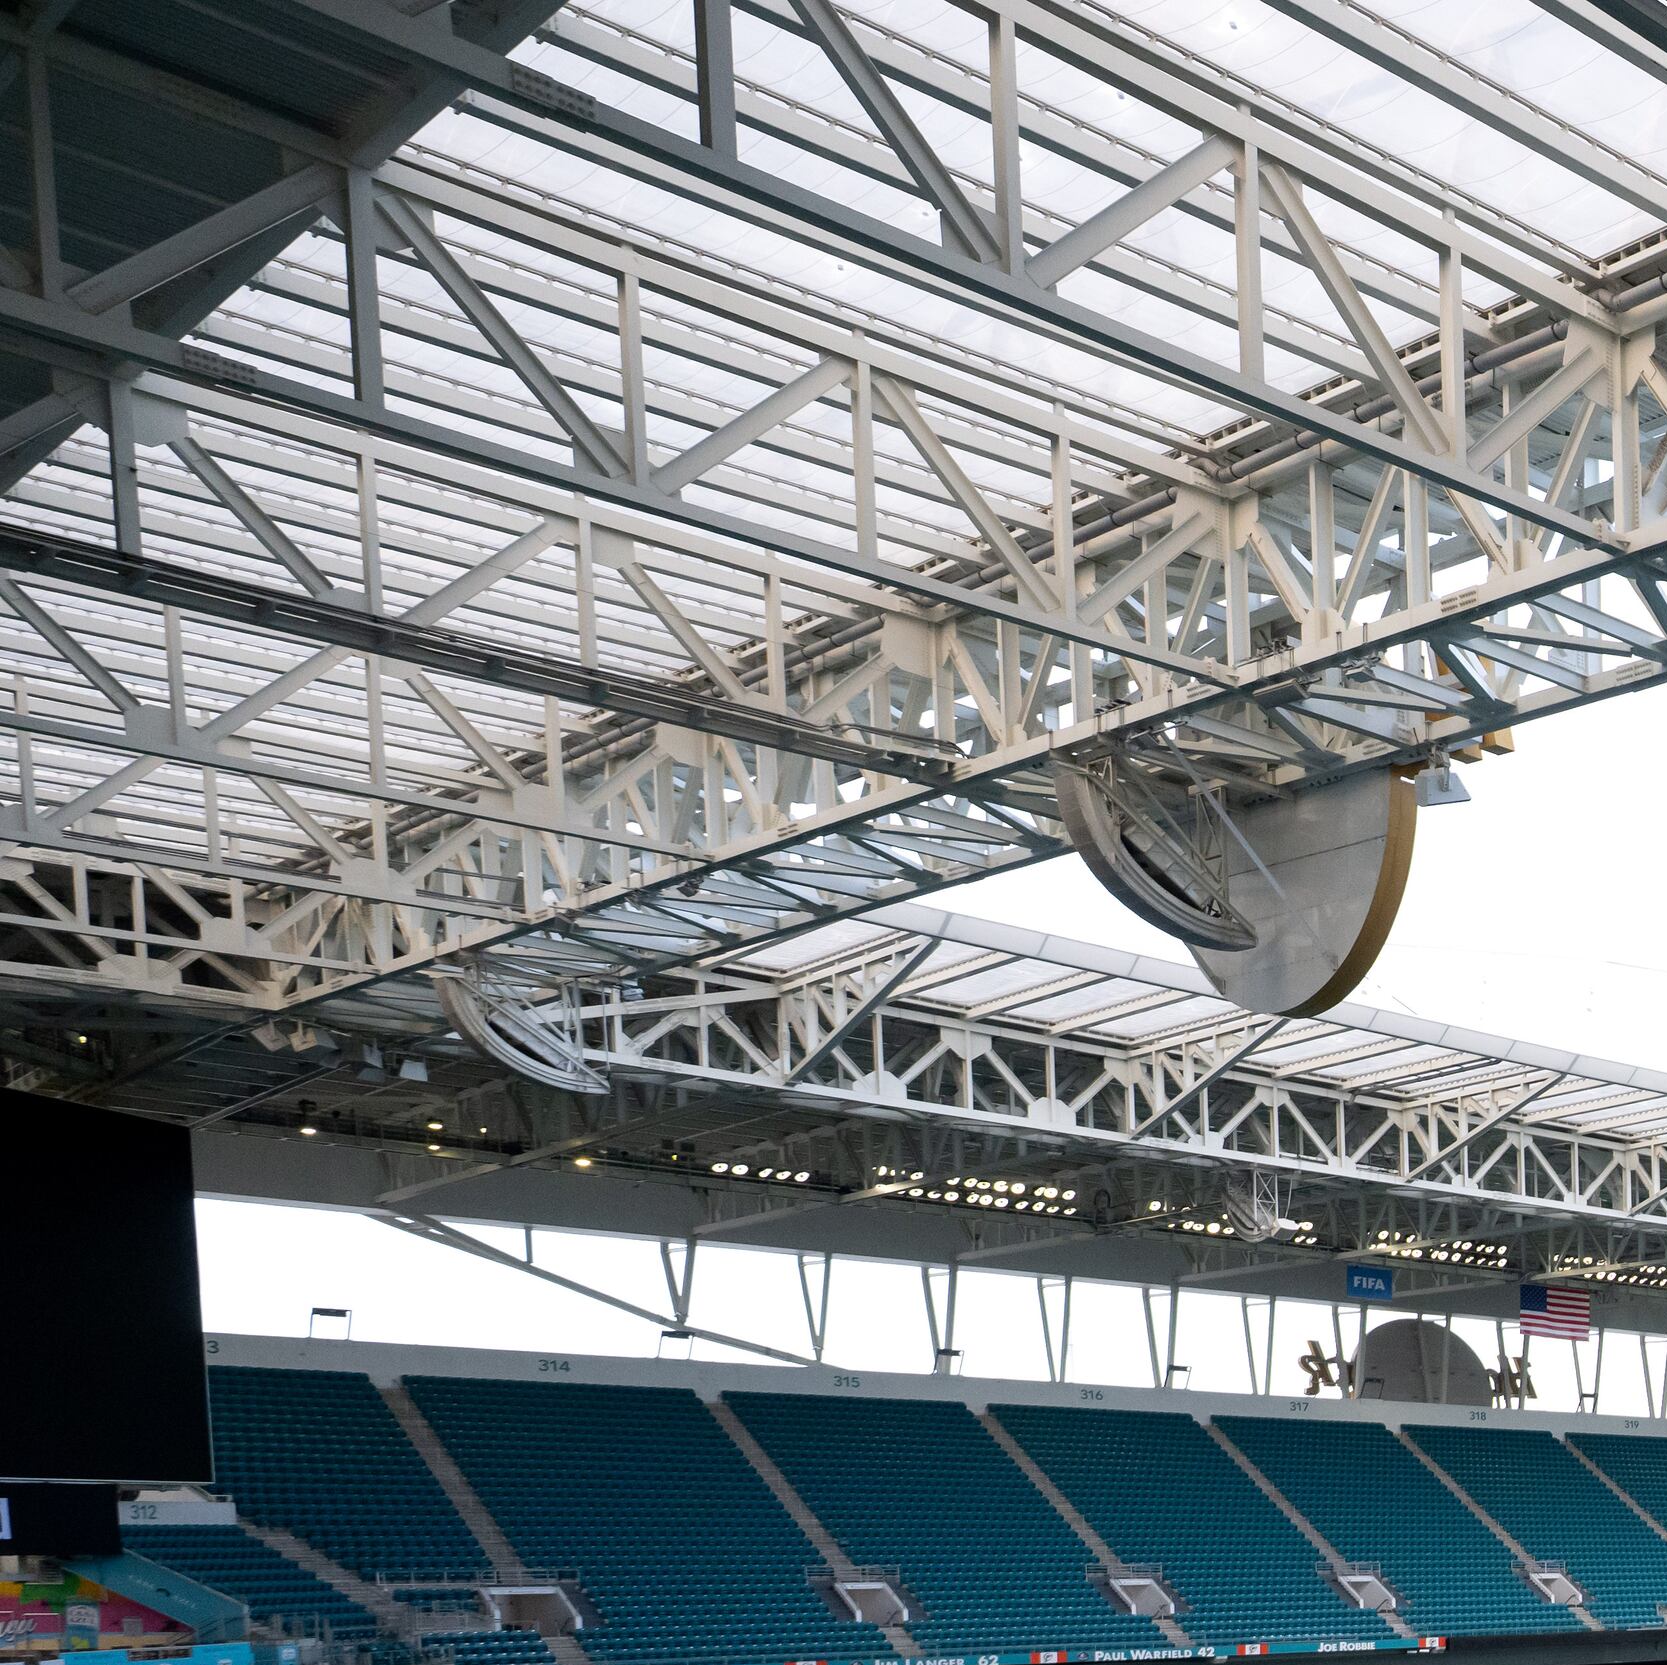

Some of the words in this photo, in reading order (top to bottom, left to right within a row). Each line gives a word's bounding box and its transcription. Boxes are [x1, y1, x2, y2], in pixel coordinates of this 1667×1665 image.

[1353, 1275, 1385, 1290] FIFA
[538, 1359, 571, 1372] 314
[833, 1375, 860, 1389] 315
[1081, 1389, 1104, 1401] 316
[1290, 1402, 1309, 1412] 317
[1469, 1411, 1487, 1421] 318
[1624, 1419, 1639, 1429] 319
[130, 1505, 157, 1520] 312
[1317, 1642, 1337, 1652] JOE
[1339, 1641, 1376, 1651] ROBBIE
[1094, 1651, 1127, 1662] PAUL
[1130, 1648, 1193, 1661] WARFIELD
[1197, 1646, 1215, 1657] 42
